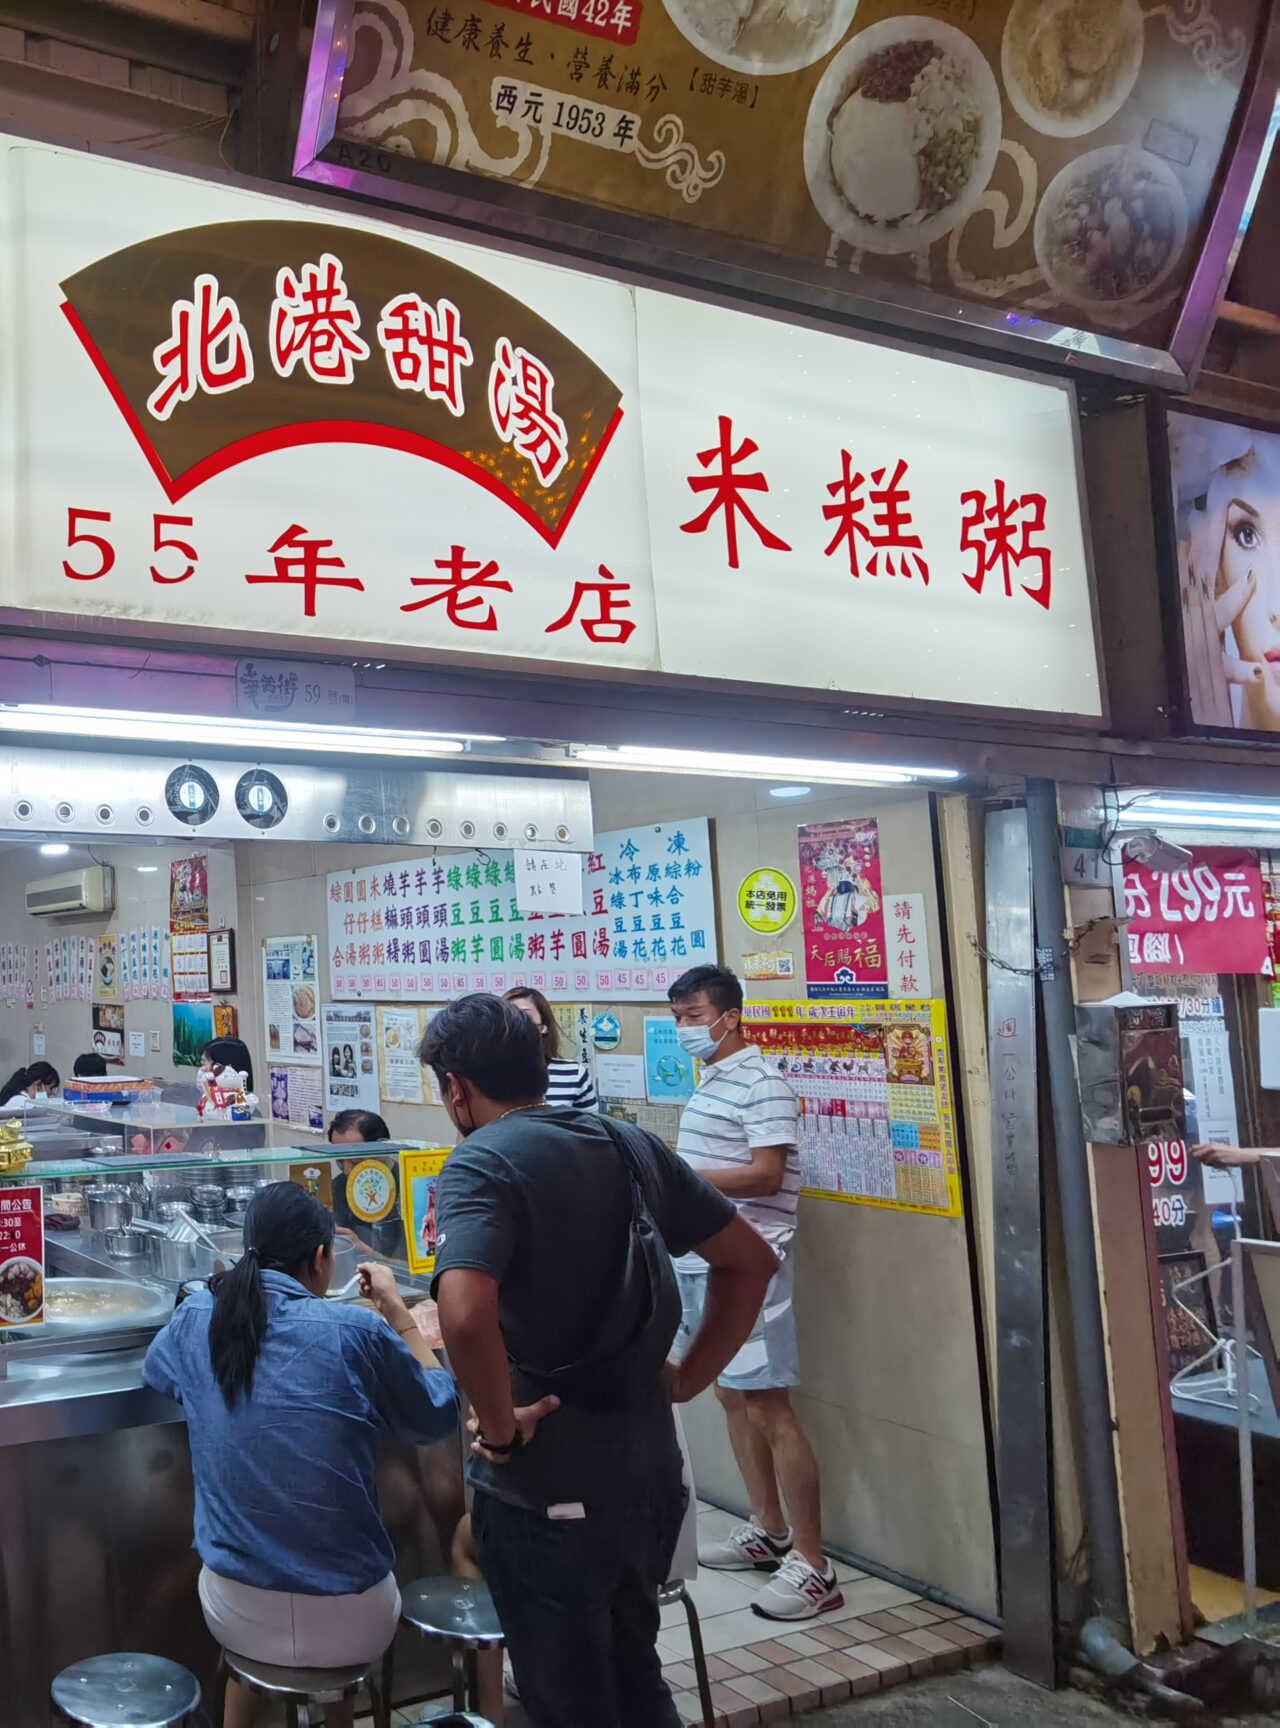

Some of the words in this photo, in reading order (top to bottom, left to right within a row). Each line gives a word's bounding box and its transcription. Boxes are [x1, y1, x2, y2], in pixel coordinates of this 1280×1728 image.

[495, 84, 544, 126] 西元
[552, 101, 604, 138] 1953
[613, 116, 637, 146] 年
[147, 253, 569, 488] 北港甜湯
[680, 415, 1052, 610] 米糕粥
[745, 900, 786, 912] 統一發票
[746, 890, 787, 901] 本店免用
[811, 938, 882, 968] 天后賜福
[893, 901, 919, 992] 請先付款
